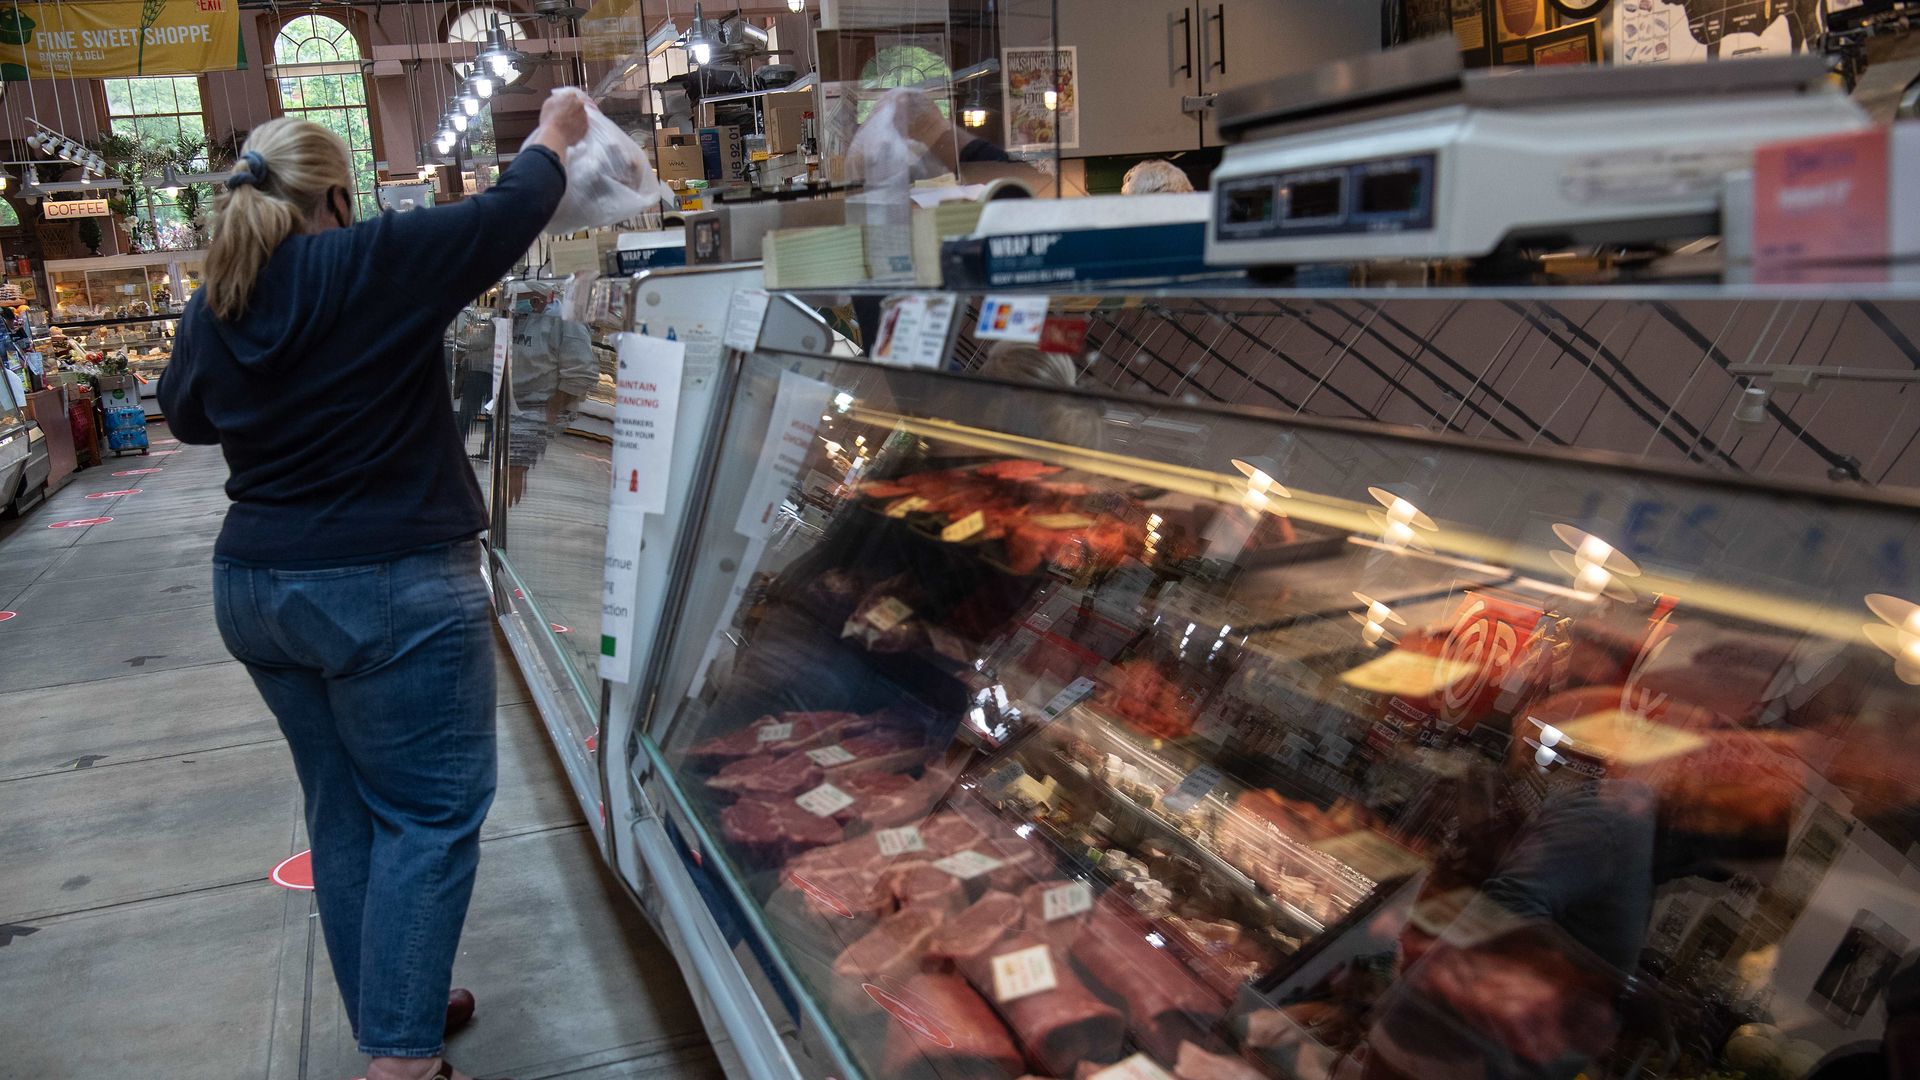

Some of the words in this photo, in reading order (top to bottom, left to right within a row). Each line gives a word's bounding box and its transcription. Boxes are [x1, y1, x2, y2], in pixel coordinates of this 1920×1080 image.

[200, 0, 222, 10] EXIT
[36, 31, 77, 50] FINE
[82, 28, 139, 49] SWEET
[144, 25, 212, 46] SHOPPE
[39, 51, 74, 63] BAKERY
[75, 51, 84, 61] &
[85, 50, 105, 61] DELI
[728, 127, 740, 141] 01
[730, 142, 741, 158] 92
[731, 161, 742, 180] HB
[48, 202, 105, 217] COFFEE
[988, 235, 1031, 259] WRAP
[621, 251, 641, 261] WRAP
[622, 418, 654, 428] MARKERS
[635, 431, 655, 440] YOUR
